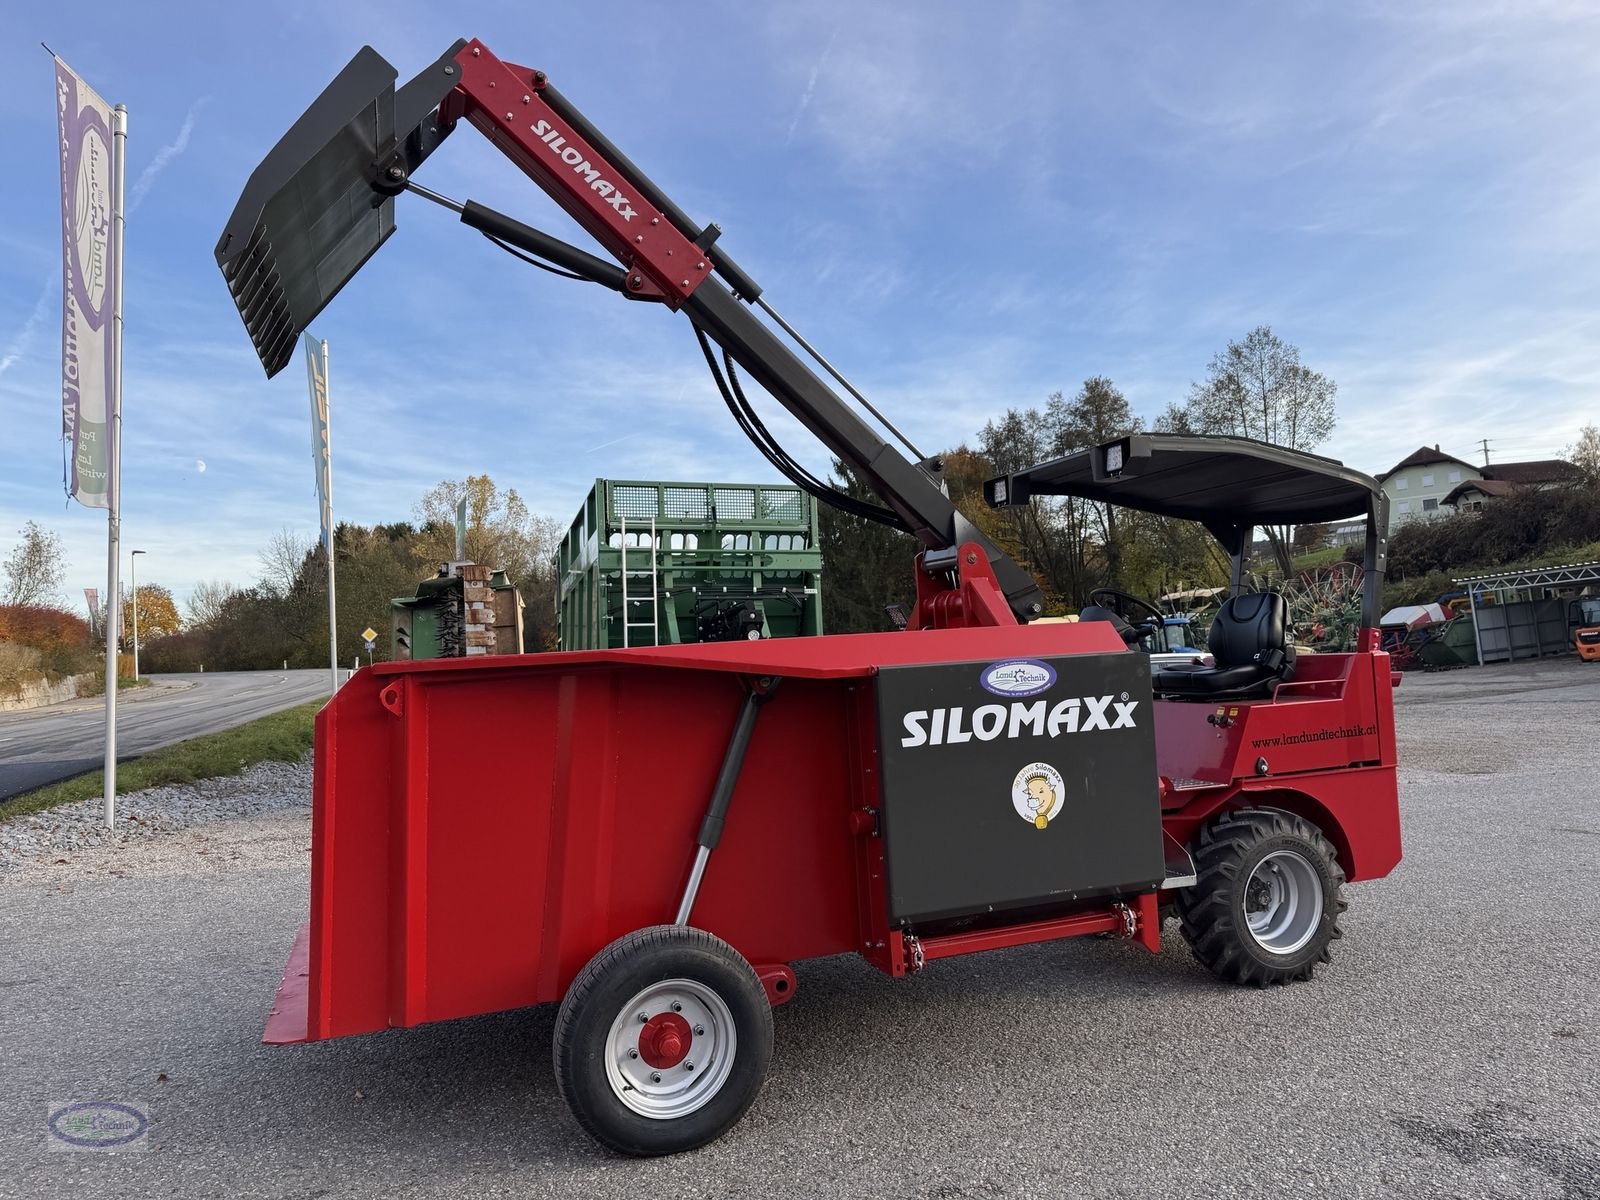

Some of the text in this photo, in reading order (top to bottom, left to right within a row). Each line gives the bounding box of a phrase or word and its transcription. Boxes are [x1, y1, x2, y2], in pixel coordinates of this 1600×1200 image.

[996, 671, 1046, 682] Land Technik
[1252, 724, 1378, 749] www.landundtechnik.at
[1035, 763, 1061, 783] Silomaxx
